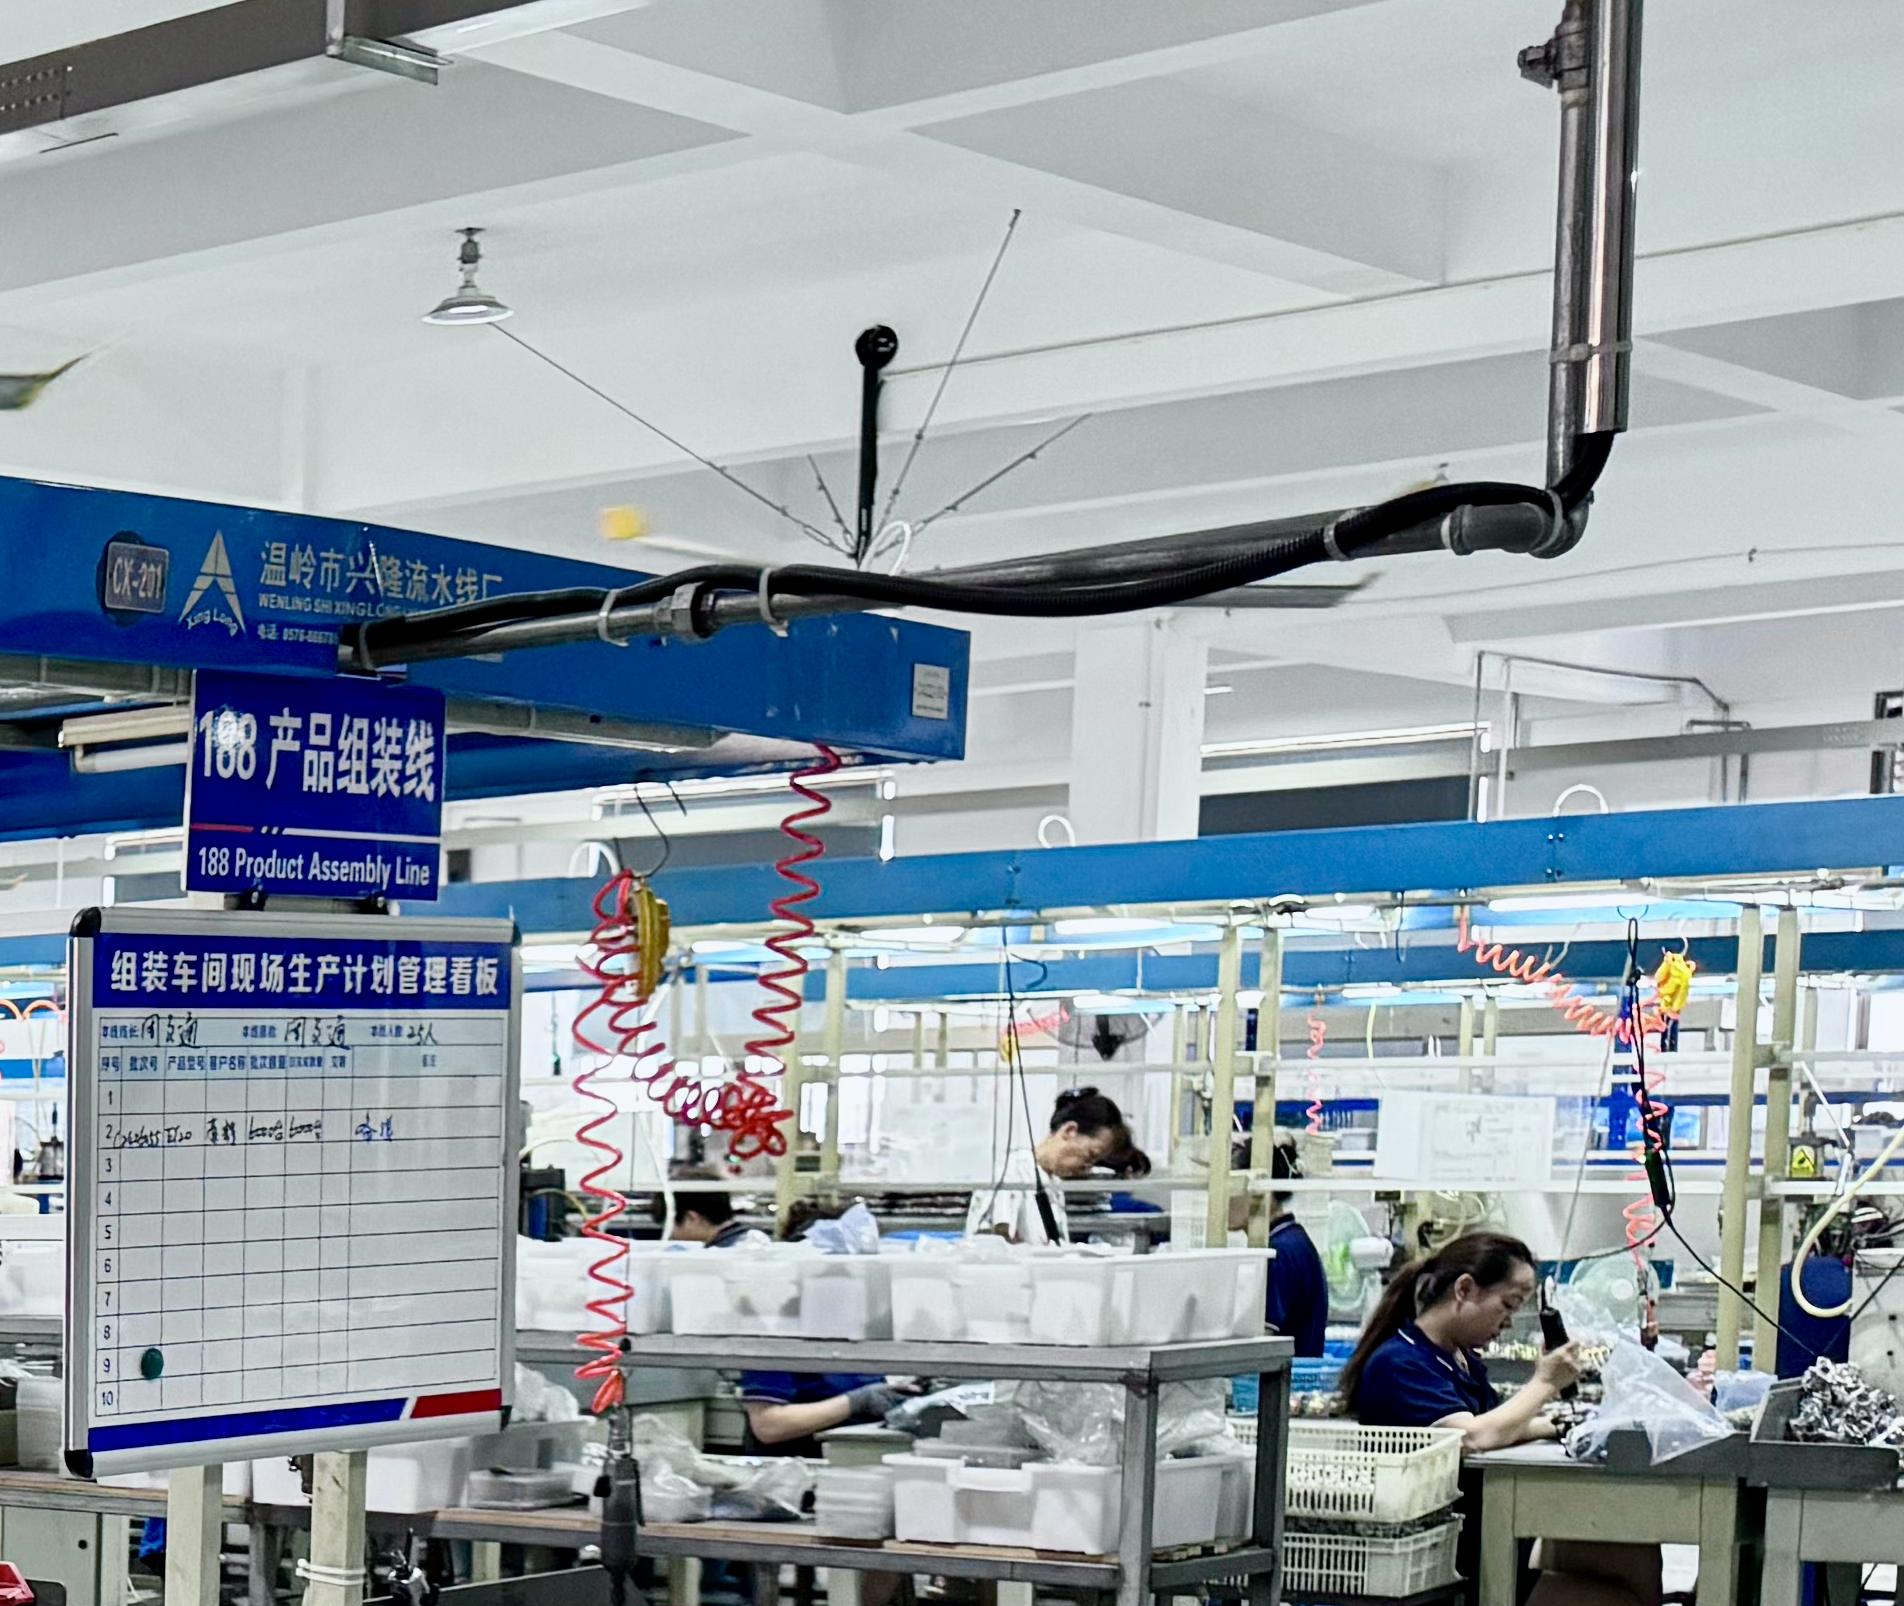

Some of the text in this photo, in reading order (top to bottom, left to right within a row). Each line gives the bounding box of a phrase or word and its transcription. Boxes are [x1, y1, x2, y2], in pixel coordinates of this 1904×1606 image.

[200, 706, 435, 802] 188 产品组装线
[199, 847, 431, 889] 188 Product Assembly Line
[111, 950, 499, 996] 组装车间现场生产计划管理看板
[109, 1090, 114, 1105] 1
[106, 1124, 112, 1139] 2
[105, 1158, 112, 1173] 3
[104, 1191, 112, 1206] 4
[104, 1225, 112, 1240] 5
[104, 1258, 111, 1273] 6
[104, 1291, 111, 1307] 7
[104, 1325, 111, 1340] 8
[103, 1358, 111, 1373] 9
[102, 1391, 114, 1406] 10
